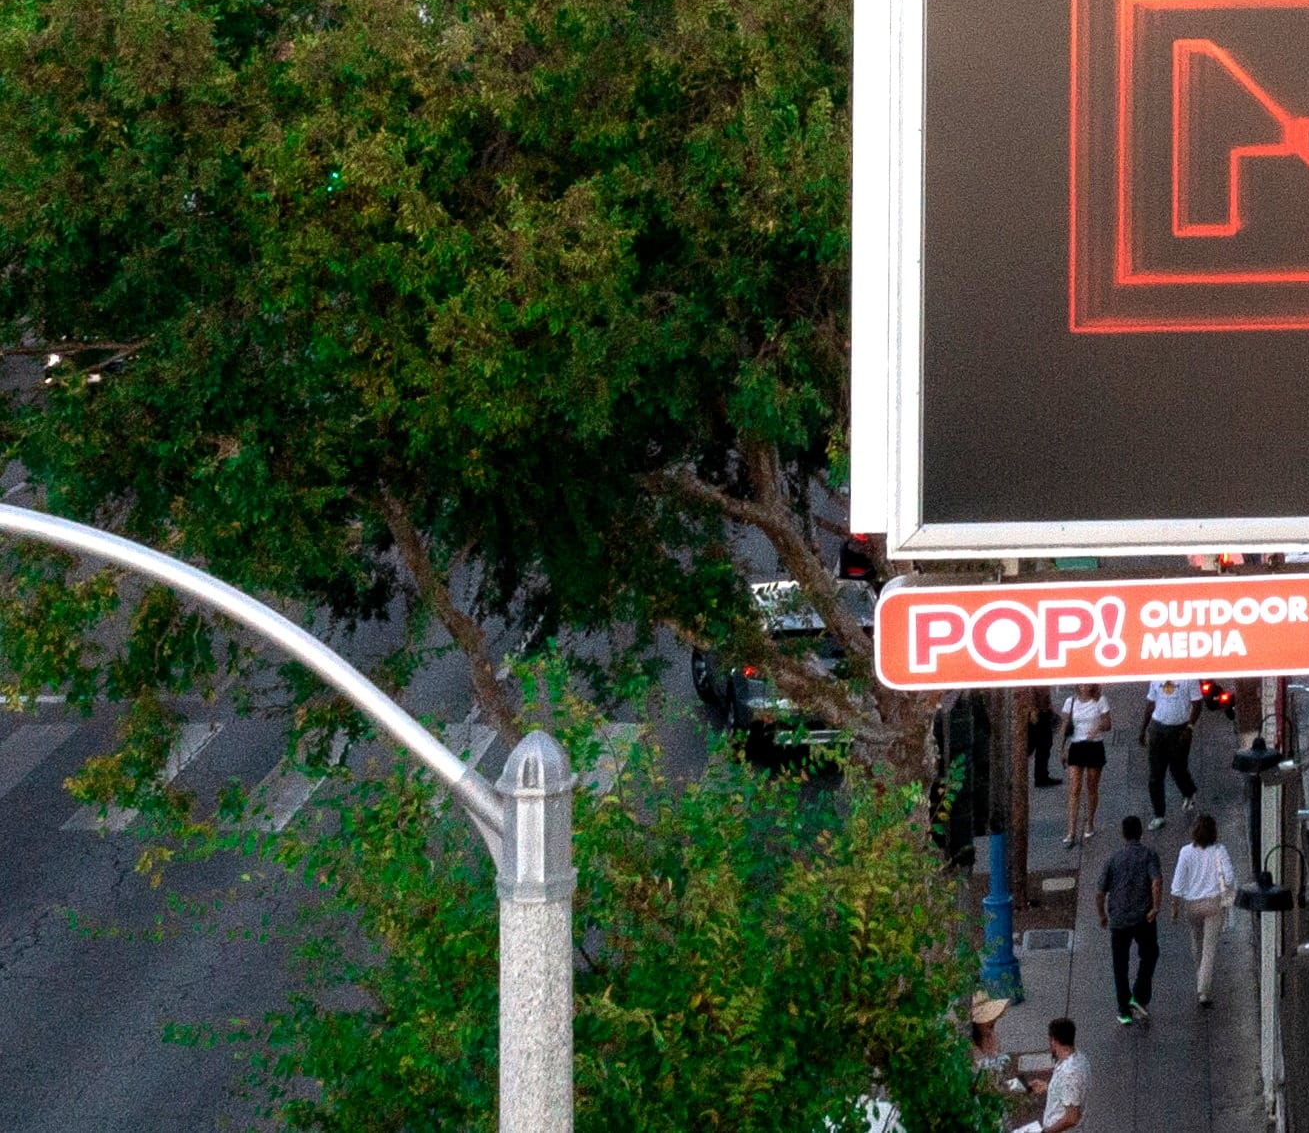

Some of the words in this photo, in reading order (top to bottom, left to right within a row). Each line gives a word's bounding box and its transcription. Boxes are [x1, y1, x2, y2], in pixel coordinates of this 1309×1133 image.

[909, 595, 1126, 673] POP!
[1140, 595, 1308, 627] OUTDOOR
[1140, 628, 1247, 660] MEDIA
